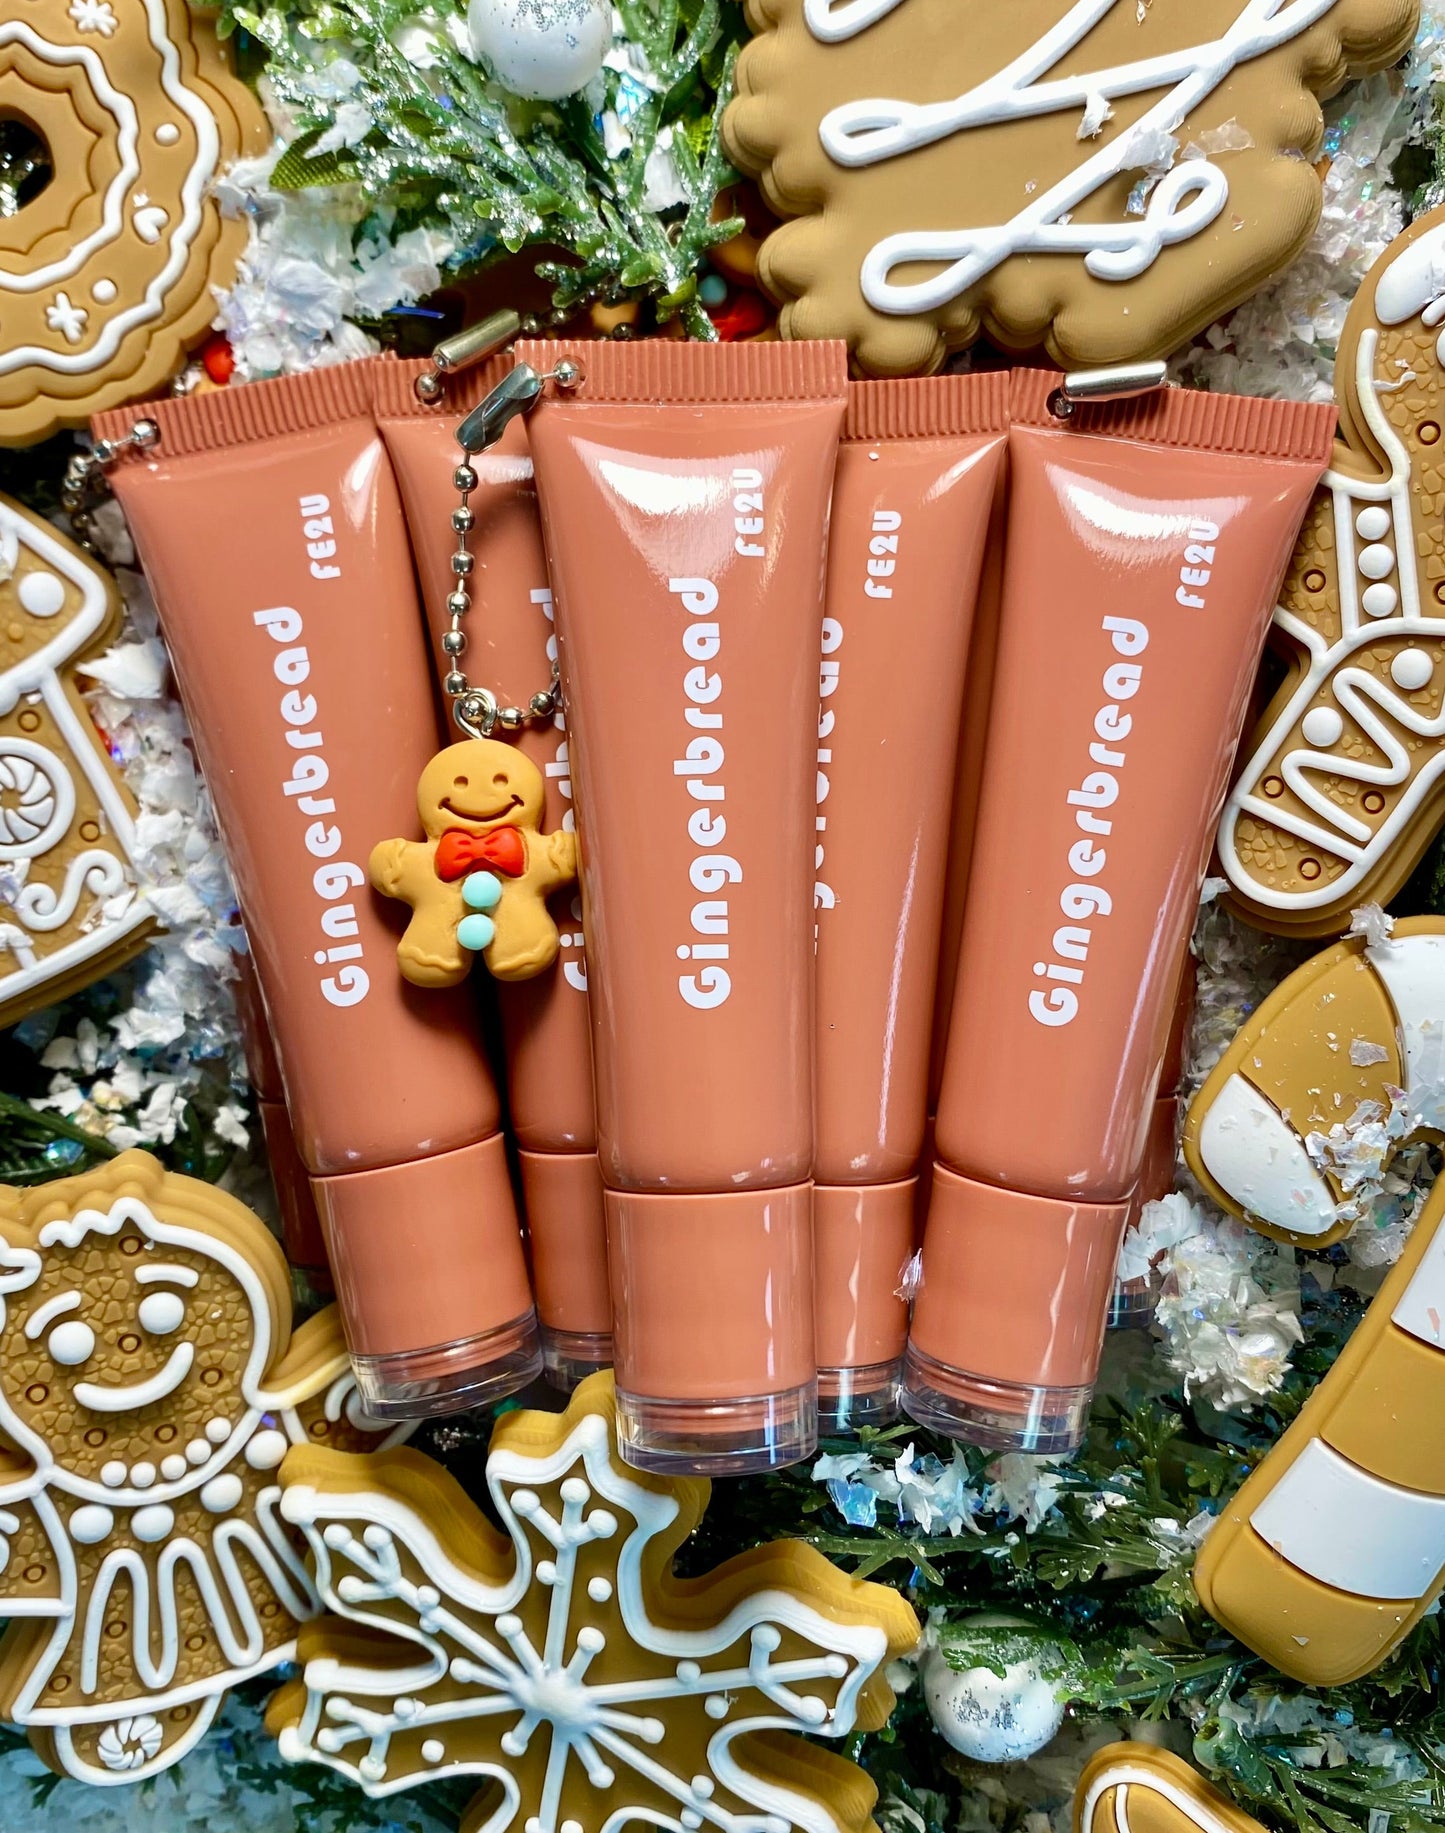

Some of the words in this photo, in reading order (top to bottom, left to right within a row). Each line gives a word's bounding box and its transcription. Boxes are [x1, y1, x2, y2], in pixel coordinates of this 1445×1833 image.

[299, 492, 341, 580] FE2U
[733, 469, 765, 557] FE2U
[864, 511, 903, 599] FE2U
[1175, 520, 1220, 609] FE2U
[253, 606, 369, 1008] Gingerbread
[669, 577, 743, 1009] Gingerbread
[1028, 615, 1149, 1027] Gingerbread
